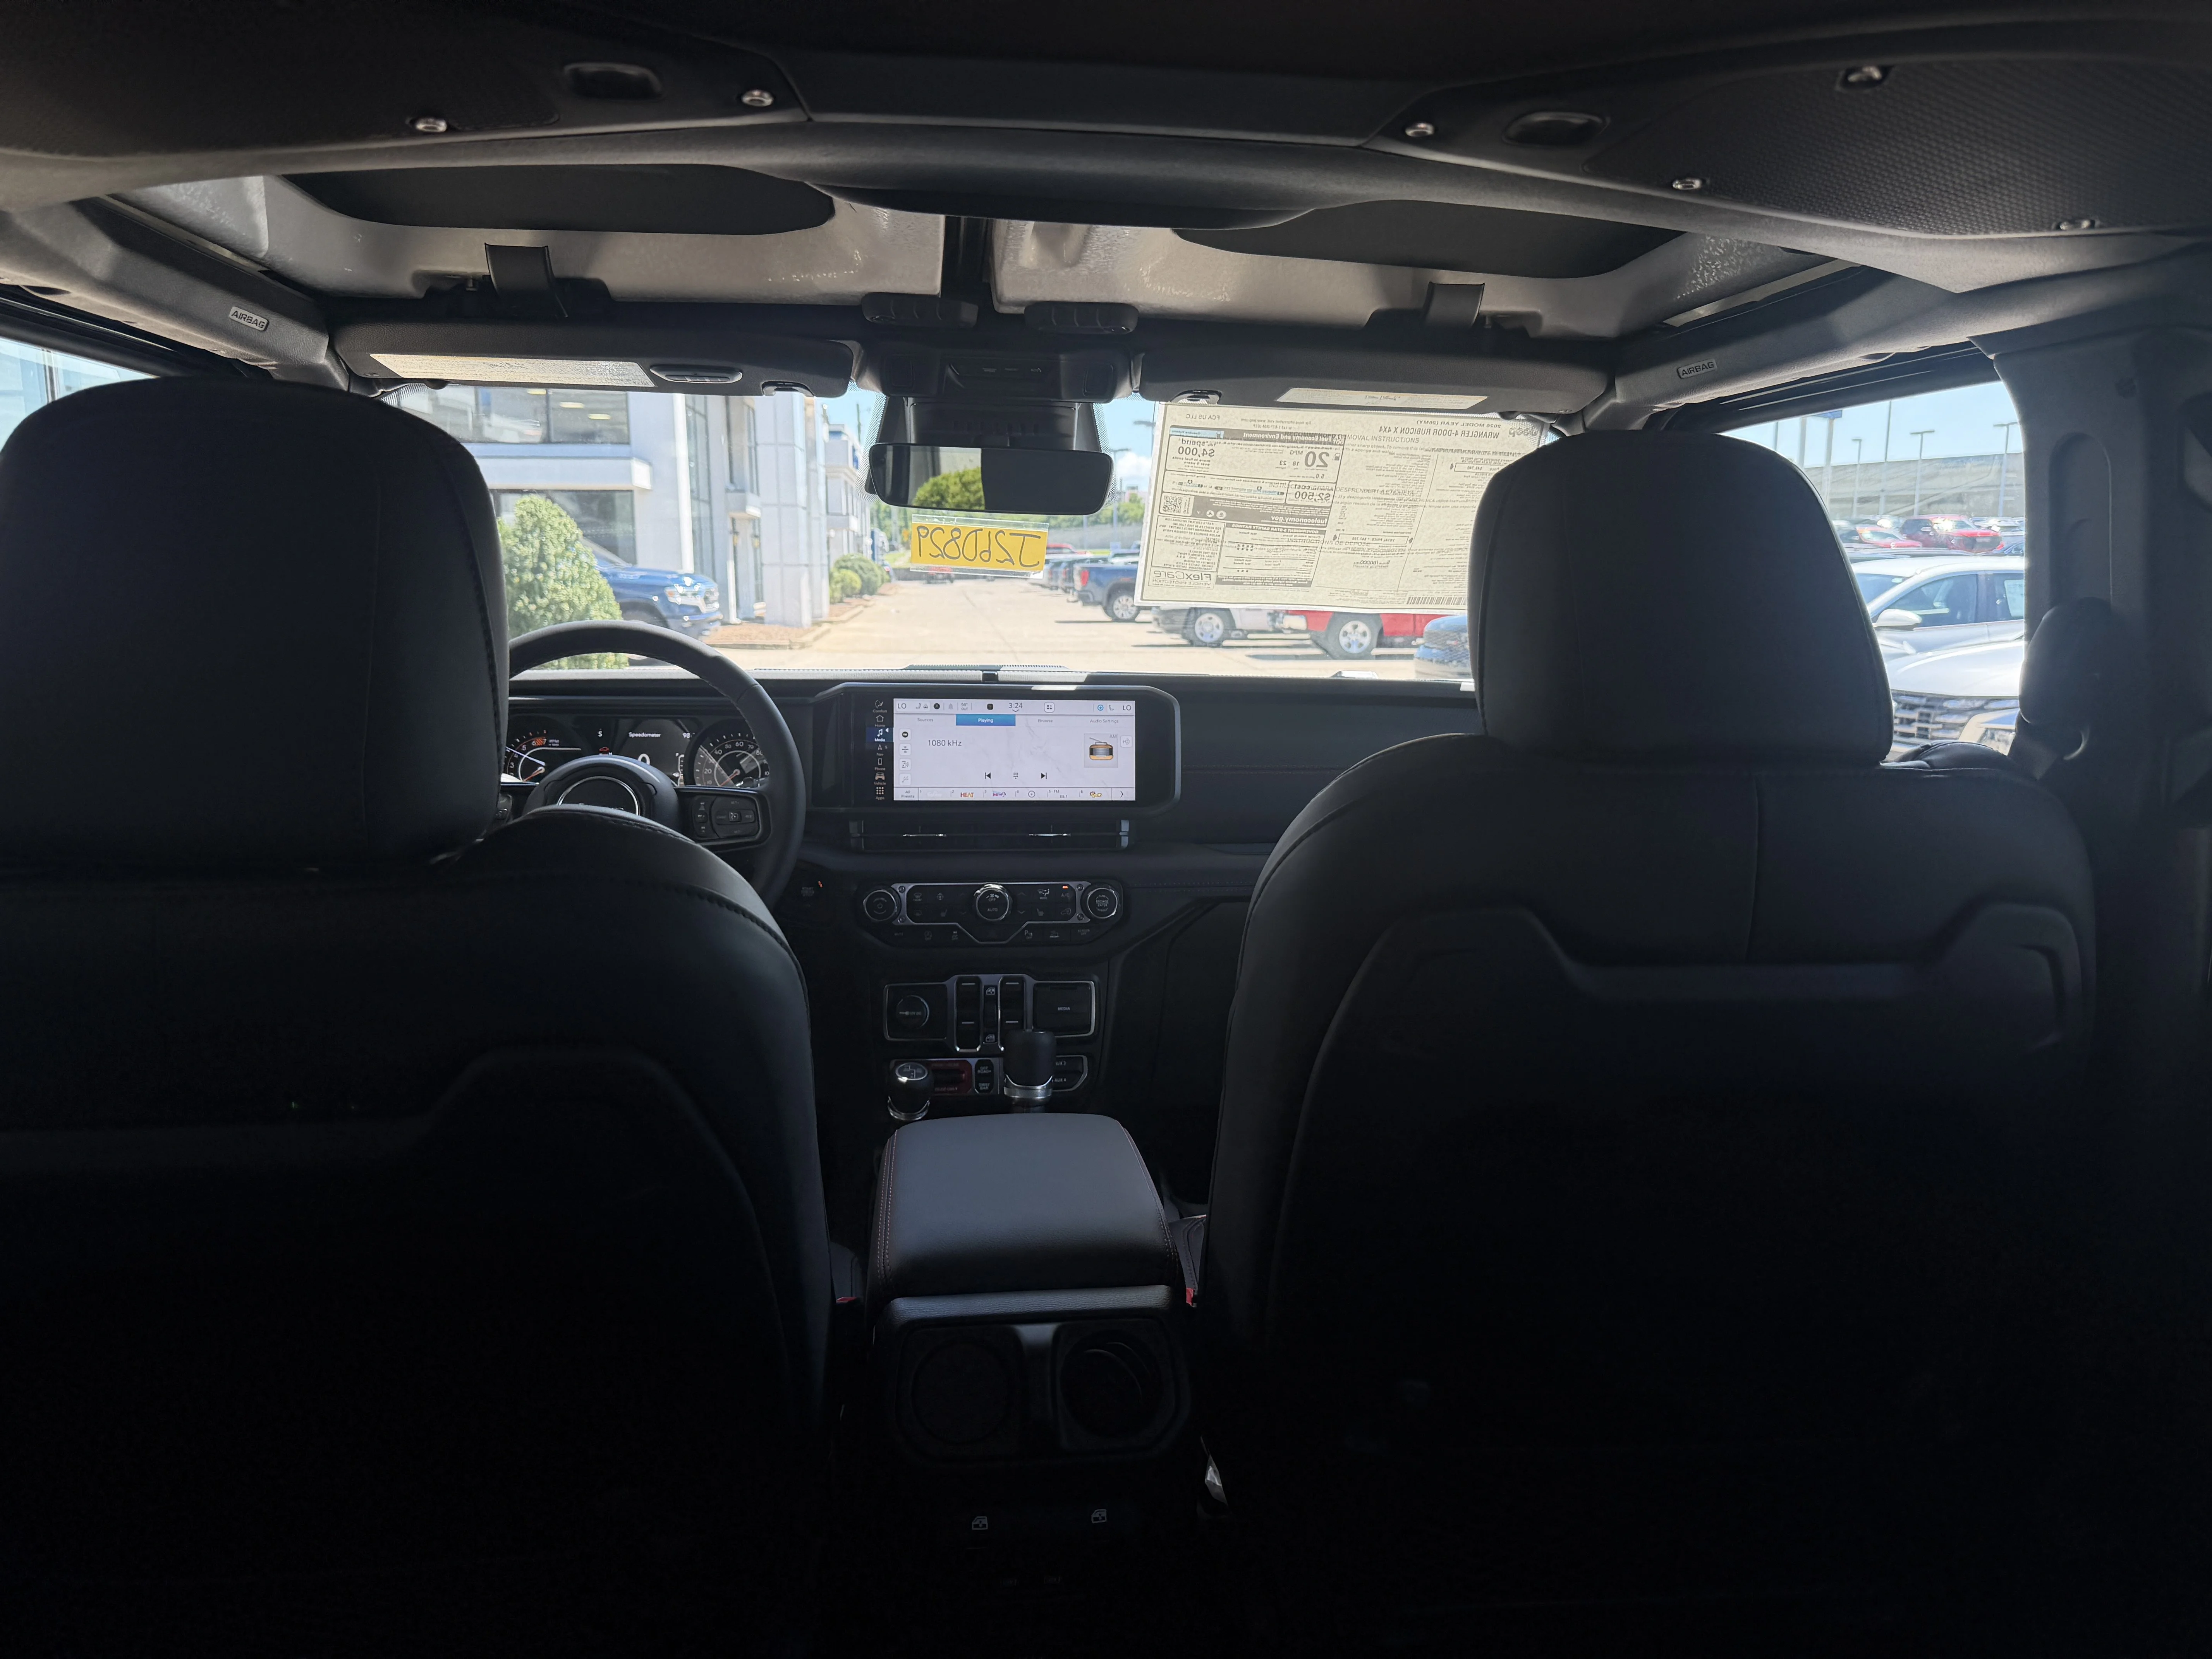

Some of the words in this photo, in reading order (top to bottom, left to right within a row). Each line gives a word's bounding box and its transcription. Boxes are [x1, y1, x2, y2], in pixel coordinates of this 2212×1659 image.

[231, 310, 265, 329] AIRBAG
[1681, 361, 1715, 376] AIRBAG
[1371, 435, 1420, 443] INSTRUCTIONS
